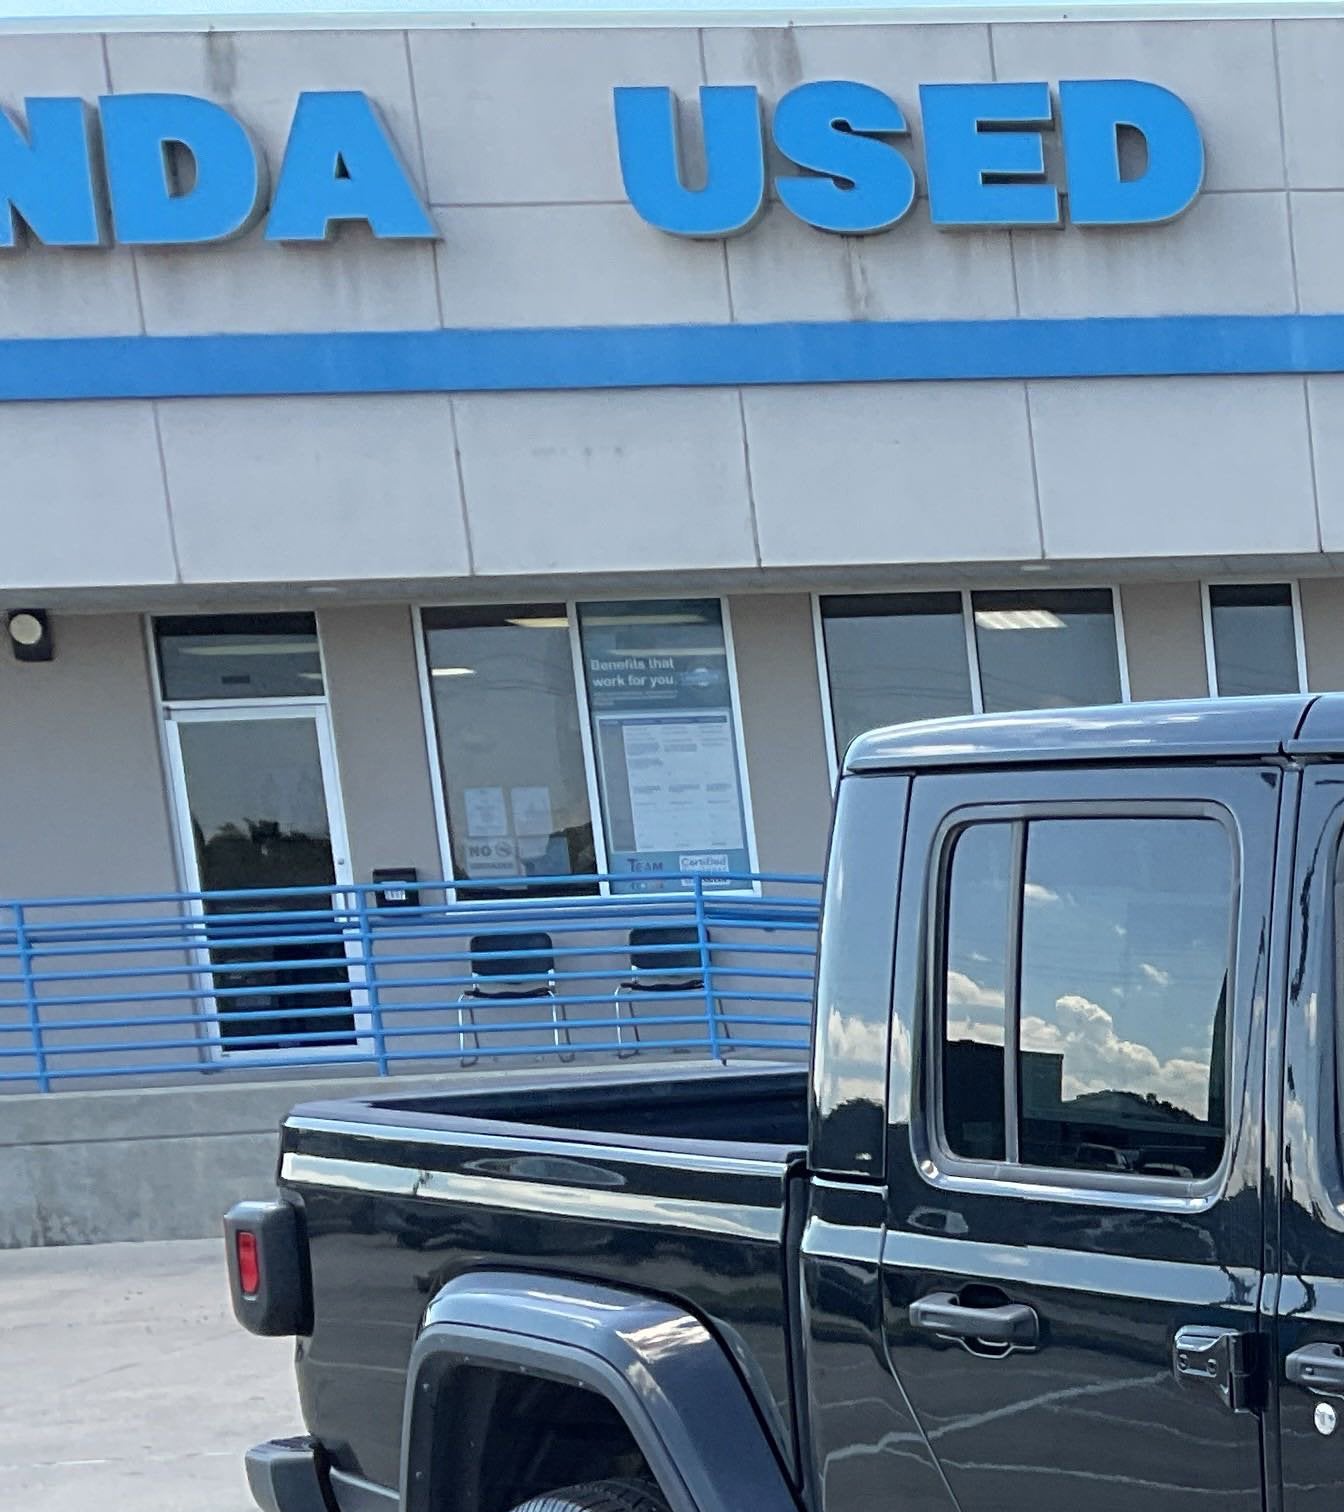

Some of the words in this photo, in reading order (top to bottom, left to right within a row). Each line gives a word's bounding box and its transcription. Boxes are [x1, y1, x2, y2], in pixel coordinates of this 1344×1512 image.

[613, 79, 1205, 237] USED
[591, 658, 646, 671] Benefits
[649, 656, 675, 670] that
[592, 676, 625, 687] work
[628, 675, 646, 686] for
[651, 676, 674, 688] you
